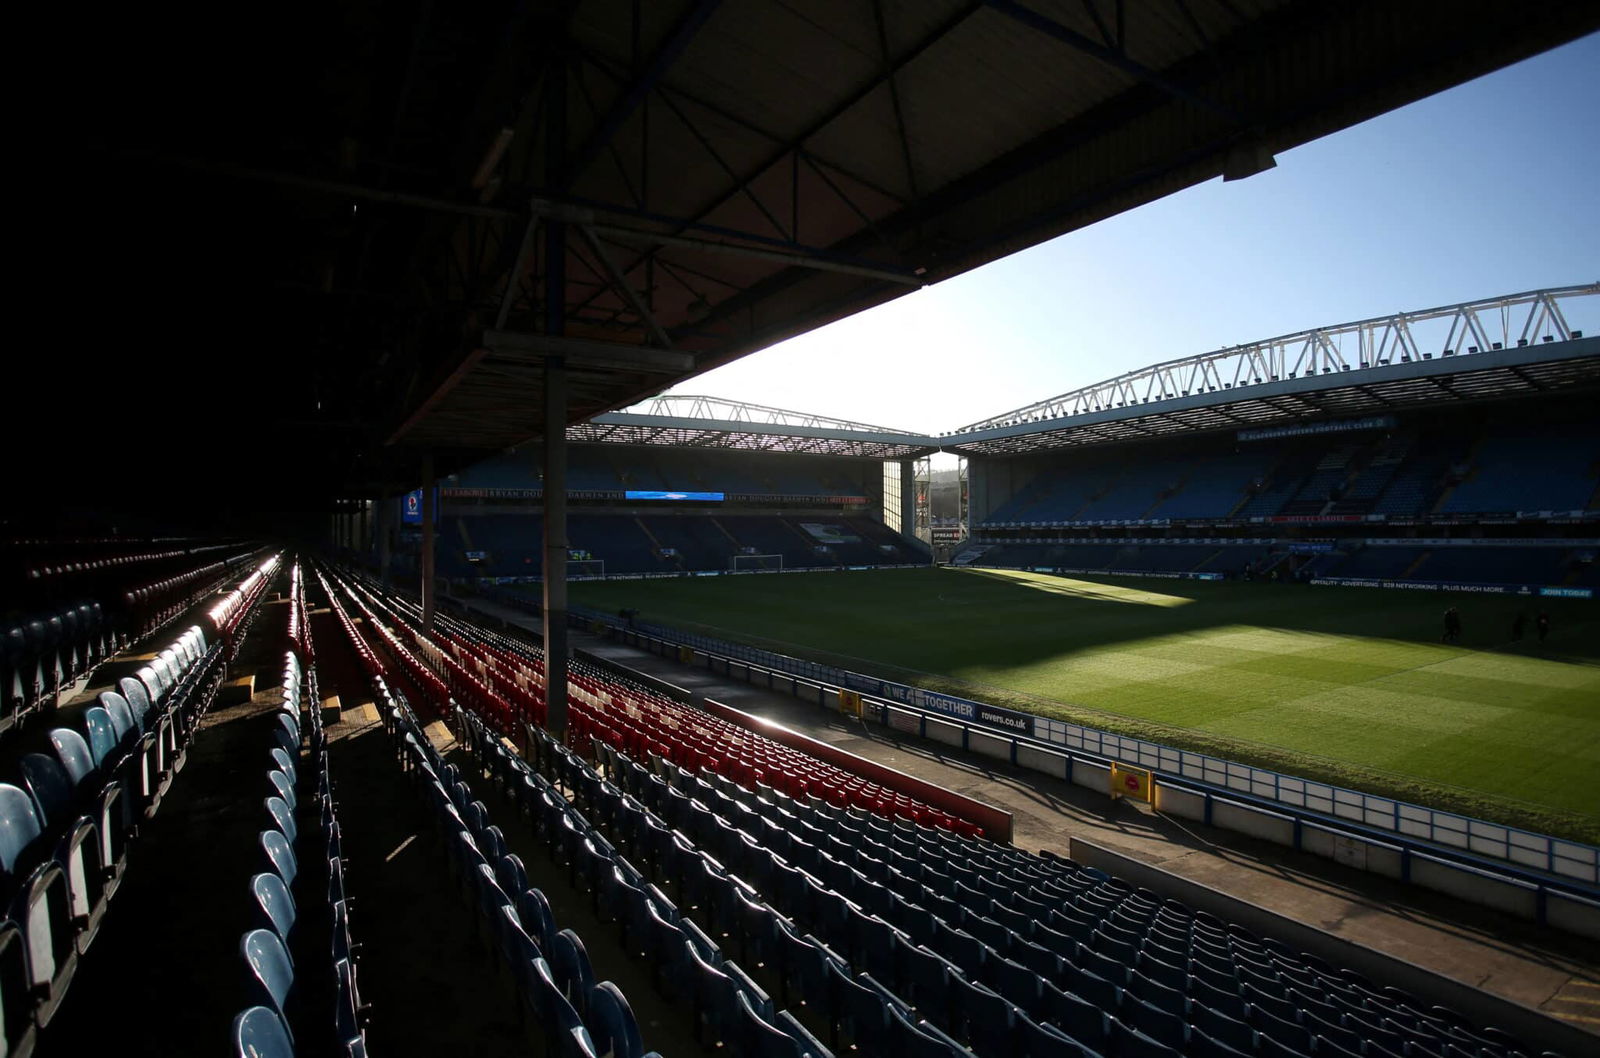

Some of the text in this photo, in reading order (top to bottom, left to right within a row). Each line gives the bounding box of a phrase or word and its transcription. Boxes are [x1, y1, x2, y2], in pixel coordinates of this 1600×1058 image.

[892, 687, 905, 700] WE
[925, 696, 973, 717] TOGETHER
[981, 712, 1026, 729] rovers.co.uk
